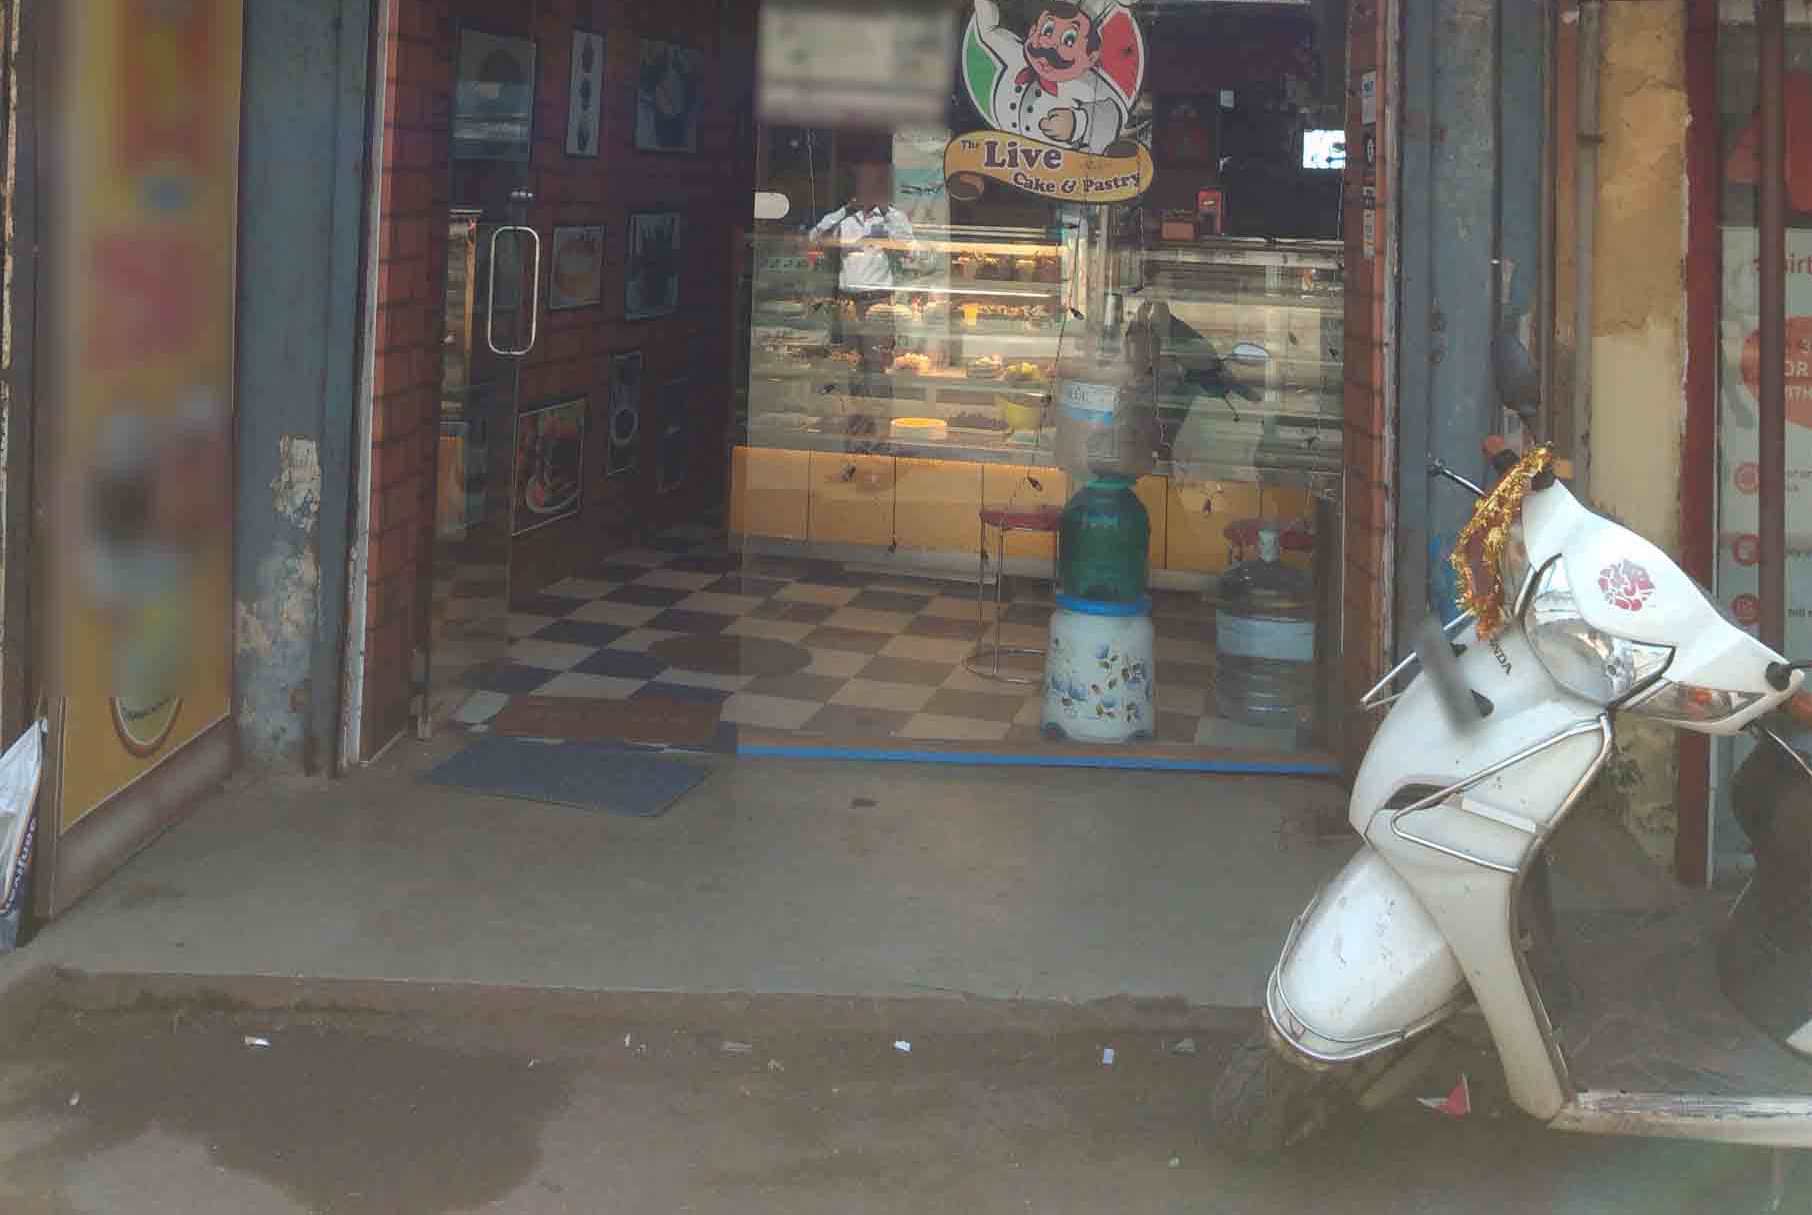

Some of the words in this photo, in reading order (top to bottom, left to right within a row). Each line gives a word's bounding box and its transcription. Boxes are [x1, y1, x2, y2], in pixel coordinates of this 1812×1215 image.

[983, 140, 1063, 170] Live
[1012, 171, 1056, 194] Cake
[1061, 178, 1077, 194] &
[1082, 171, 1141, 193] Pastry
